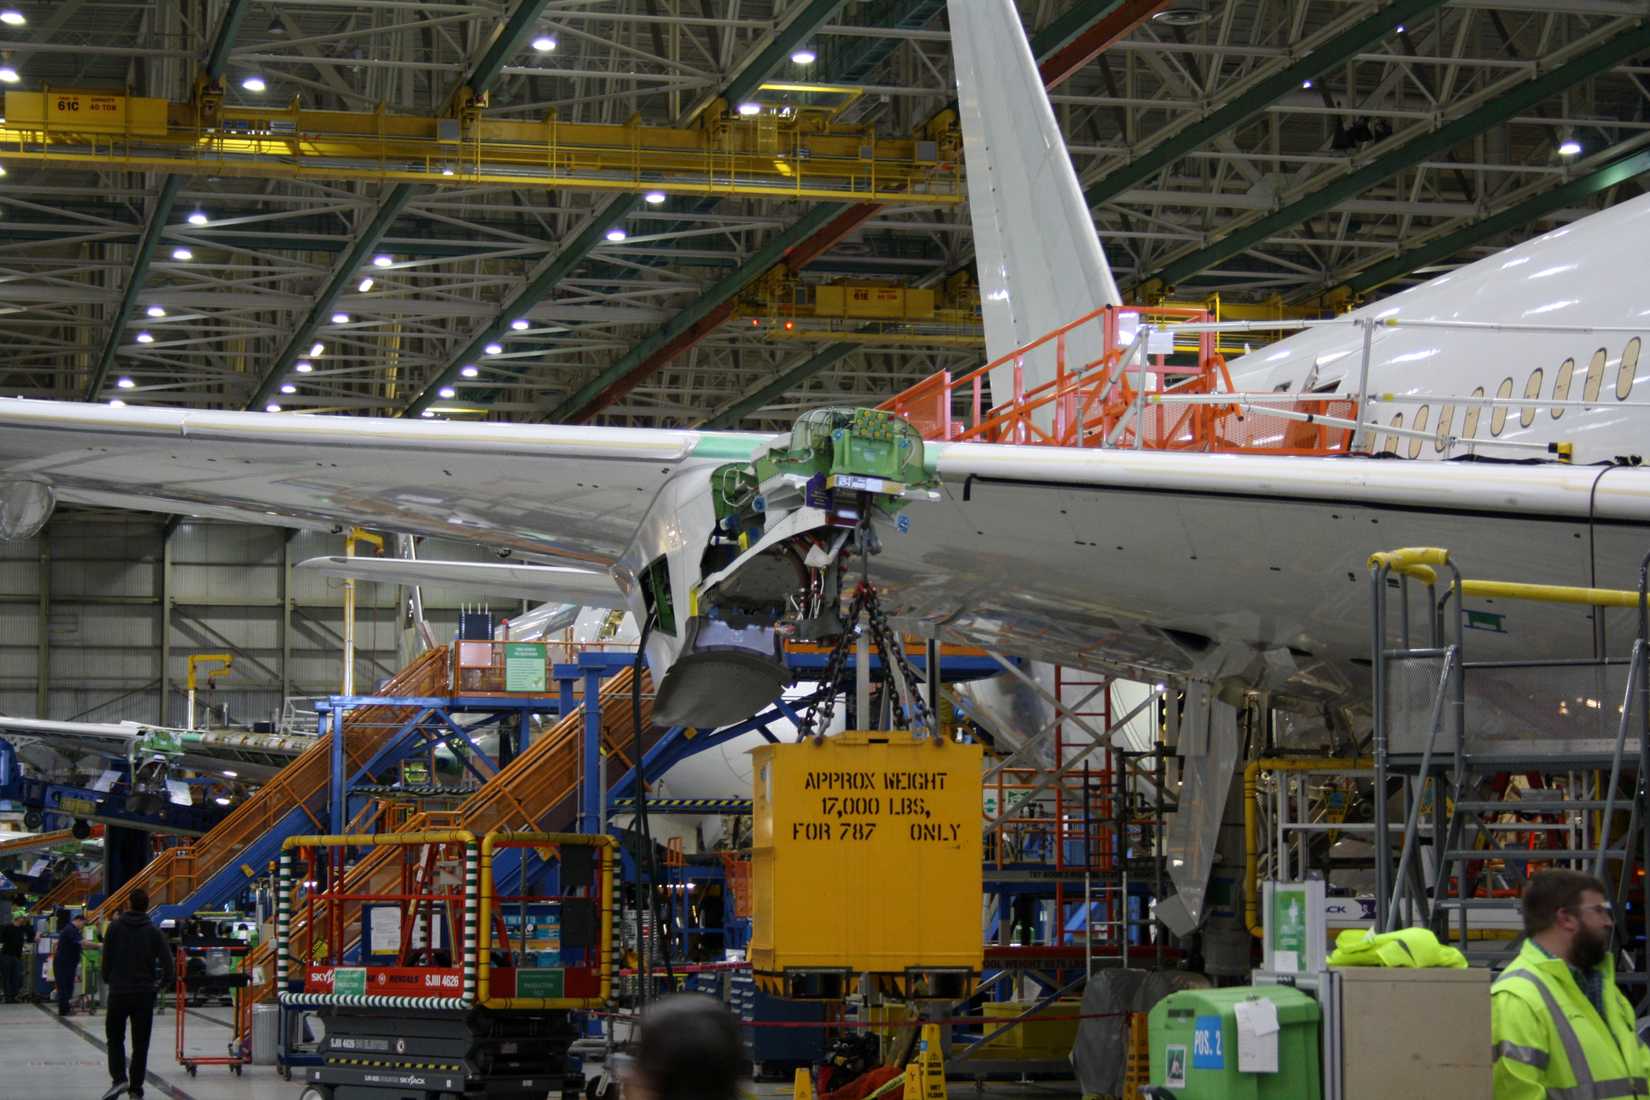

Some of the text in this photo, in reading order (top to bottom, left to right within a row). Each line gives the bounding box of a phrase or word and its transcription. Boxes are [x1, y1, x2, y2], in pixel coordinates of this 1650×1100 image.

[58, 101, 79, 111] 61C
[805, 772, 947, 790] APPROX WEIGHT
[822, 797, 931, 818] 17,000 LBS,
[793, 823, 961, 841] FOR 787 ONLY
[1194, 1030, 1222, 1056] POS. 2
